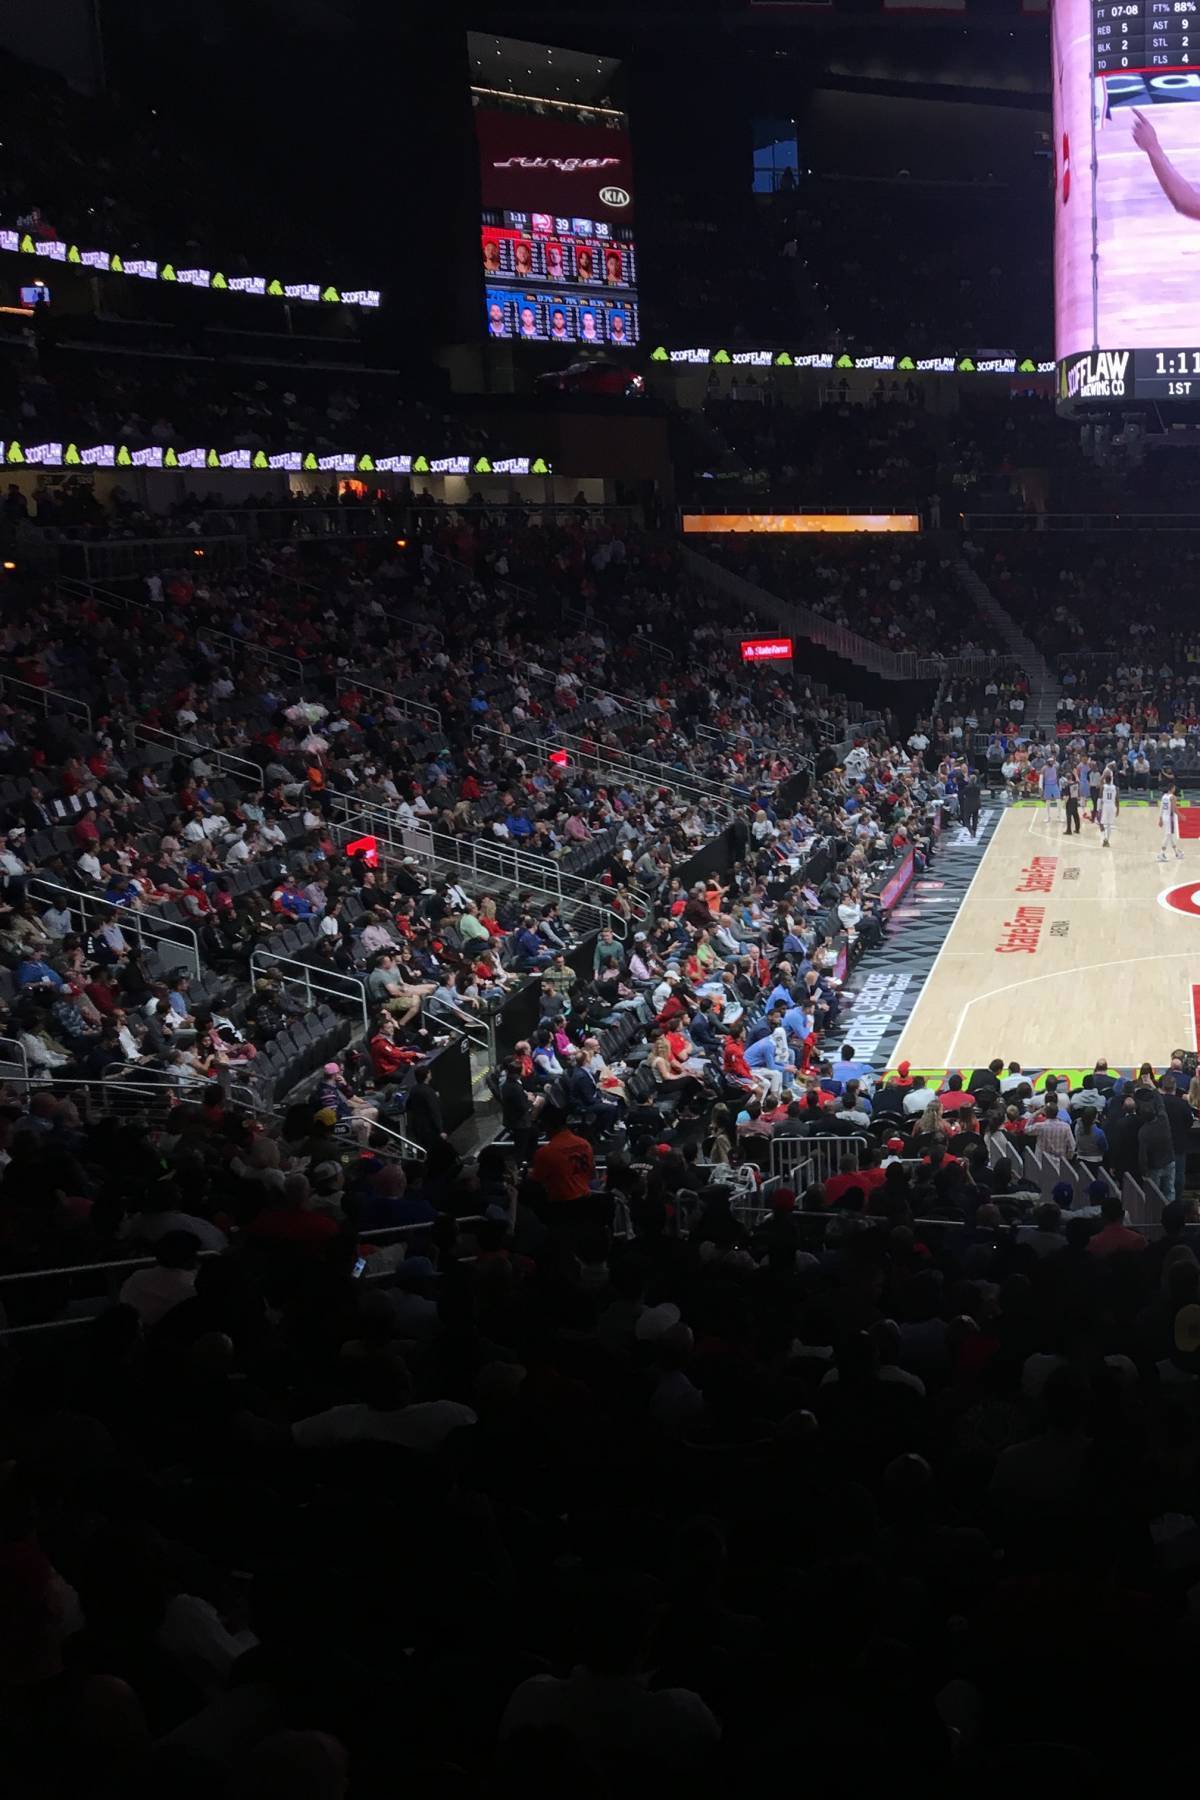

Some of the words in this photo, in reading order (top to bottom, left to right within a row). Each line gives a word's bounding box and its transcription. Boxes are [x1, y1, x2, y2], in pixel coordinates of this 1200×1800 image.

[1097, 9, 1105, 18] FT
[1111, 5, 1138, 17] 07-08
[1153, 3, 1170, 13] FT%
[1174, 1, 1196, 12] 88%
[1097, 25, 1111, 35] REB
[1121, 23, 1128, 33] 5
[1152, 20, 1168, 30] AST
[1181, 19, 1189, 29] 9
[1097, 42, 1111, 52] BLK
[1121, 40, 1128, 50] 2
[1152, 38, 1168, 47] STL
[1182, 36, 1189, 47] 2
[1098, 60, 1106, 69] TO
[1121, 57, 1128, 67] 0
[1153, 55, 1168, 64] FLS
[1181, 53, 1189, 63] 4
[604, 189, 624, 203] KIA
[555, 218, 569, 231] 39
[595, 223, 609, 235] 38
[228, 277, 266, 290] SCOFFLAW
[341, 290, 380, 303] SCOFFLAW
[670, 349, 710, 361] SCOFFLAW
[732, 351, 772, 364] SCOFFLAW
[794, 354, 833, 366] SCOFFLAW
[855, 356, 895, 368] SCOFFLAW
[916, 358, 955, 370] SCOFFLAW
[976, 359, 1016, 371] SCOFFLAW
[1080, 380, 1110, 397] BREWING
[1111, 379, 1125, 396] CO
[1168, 382, 1191, 395] 1ST
[318, 453, 356, 470] SCOFFLAW
[375, 455, 411, 471] SCOFFLAW
[430, 456, 470, 472] SCOFFLAW
[492, 457, 529, 473] SCOFFLAW
[850, 973, 894, 1012] CHEROKEE
